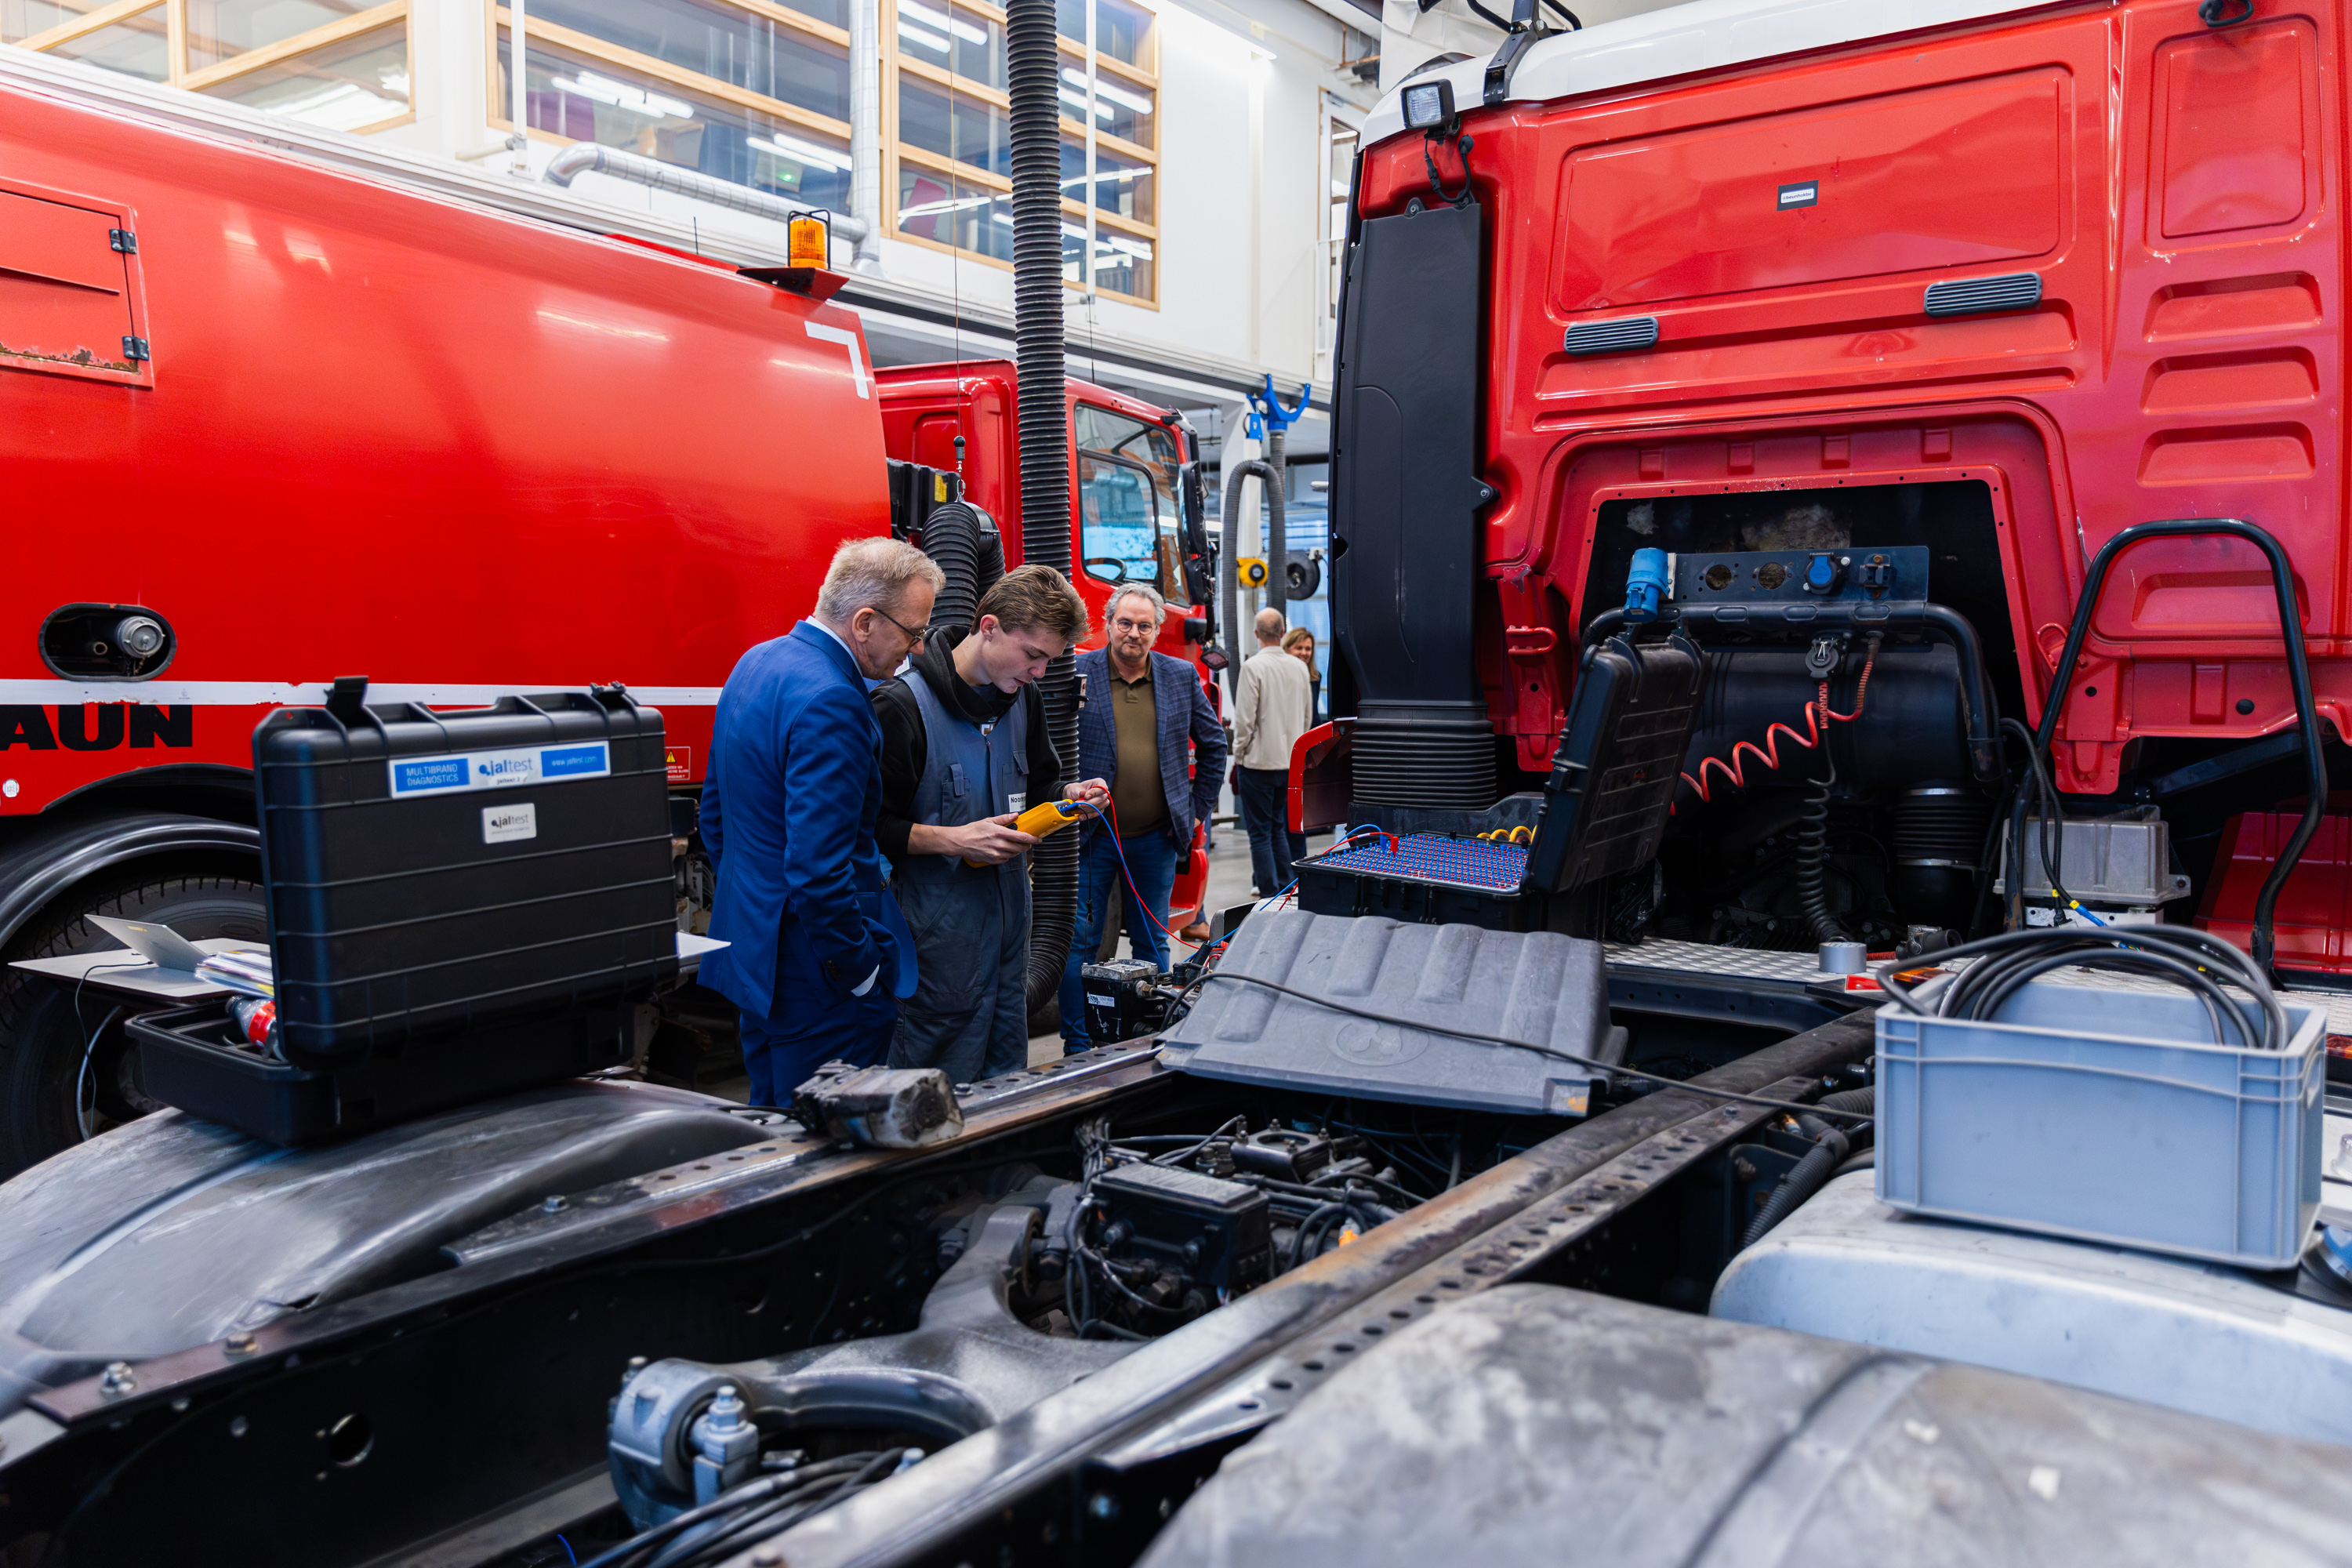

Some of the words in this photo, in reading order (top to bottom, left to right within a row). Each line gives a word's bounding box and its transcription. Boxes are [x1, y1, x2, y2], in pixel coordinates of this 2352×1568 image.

[406, 764, 458, 776] MULTIBRAND
[489, 757, 533, 777] jaltest
[407, 773, 459, 786] DIAGNOSTICS
[498, 813, 529, 829] jaltest
